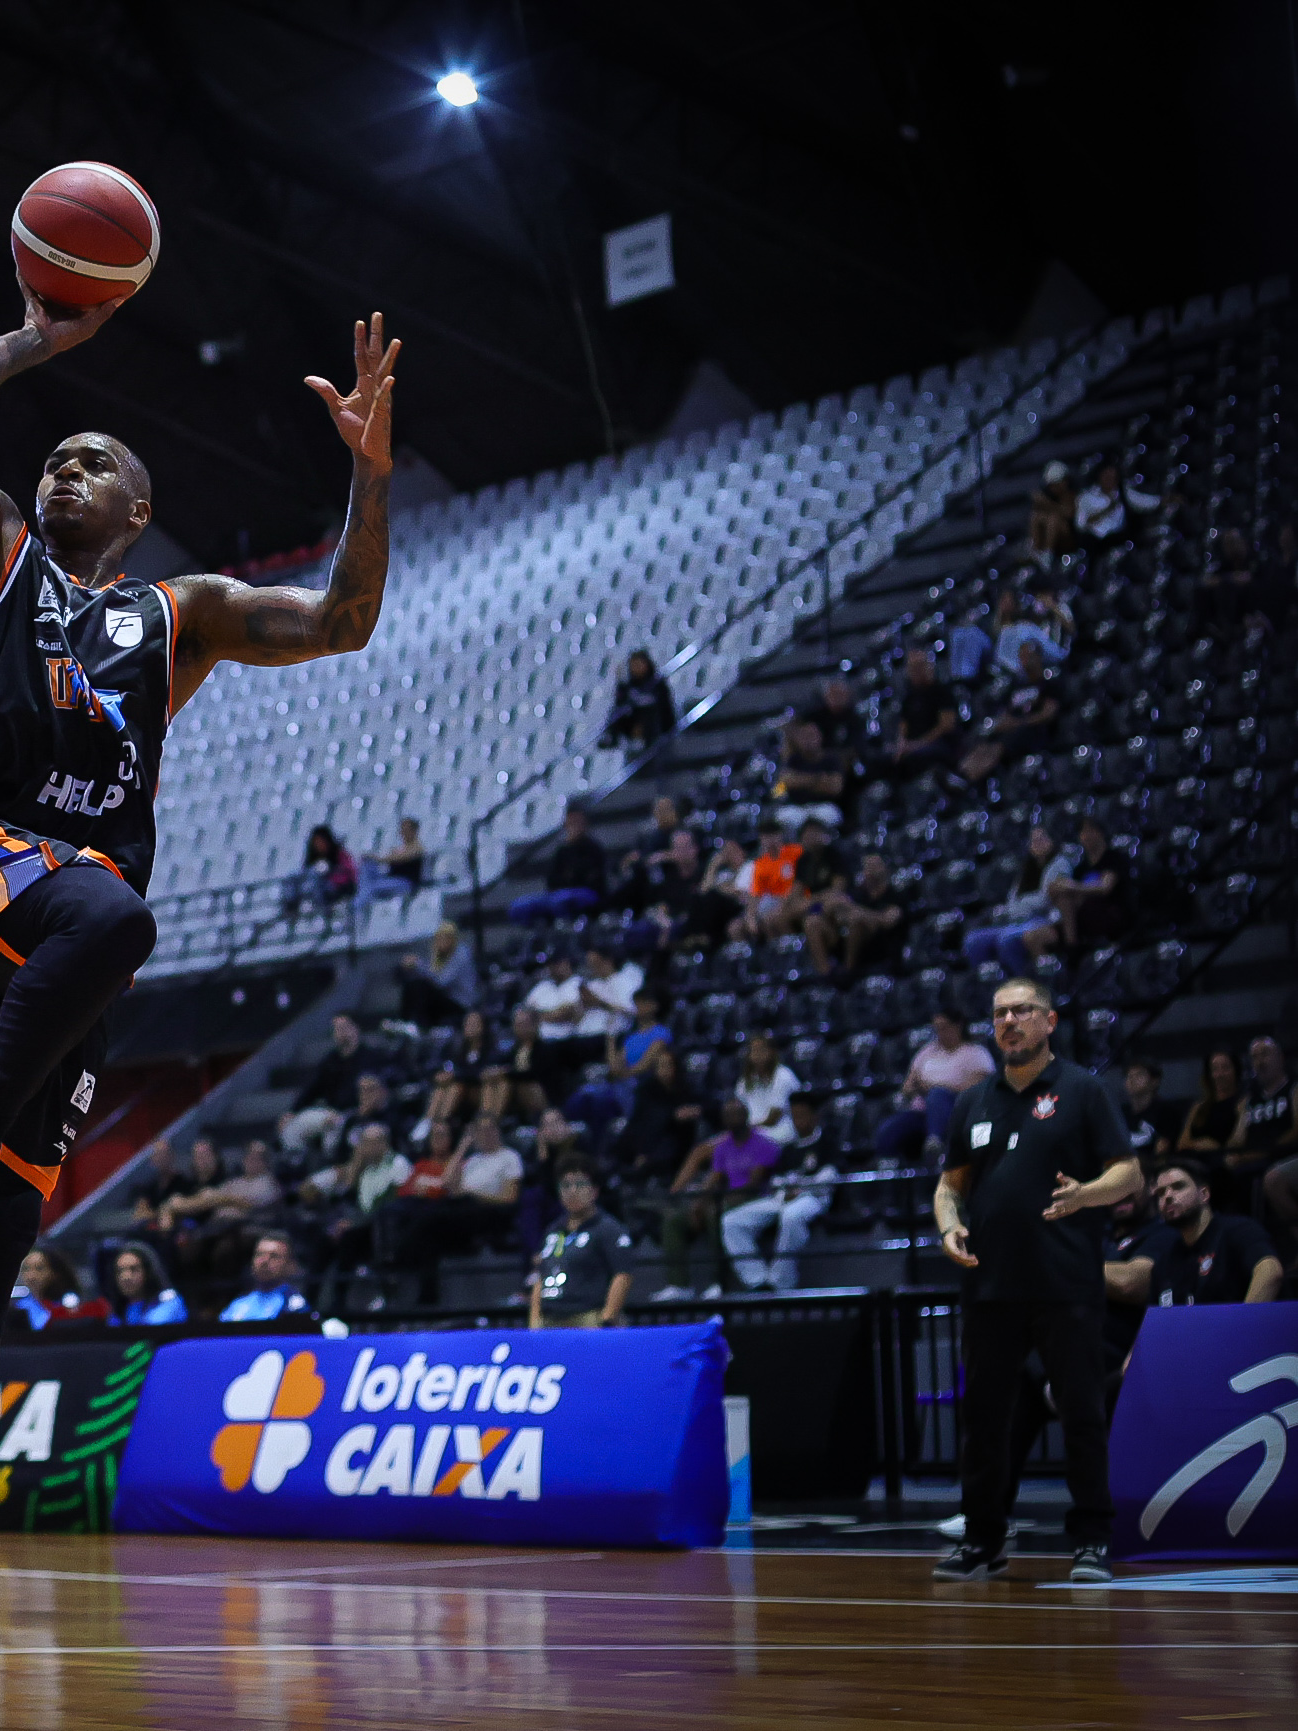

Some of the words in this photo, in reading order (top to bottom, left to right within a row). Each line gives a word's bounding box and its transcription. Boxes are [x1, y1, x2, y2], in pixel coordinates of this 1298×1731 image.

[36, 770, 126, 817] HELP
[340, 1341, 568, 1415] loterias
[323, 1422, 545, 1502] CAIXA
